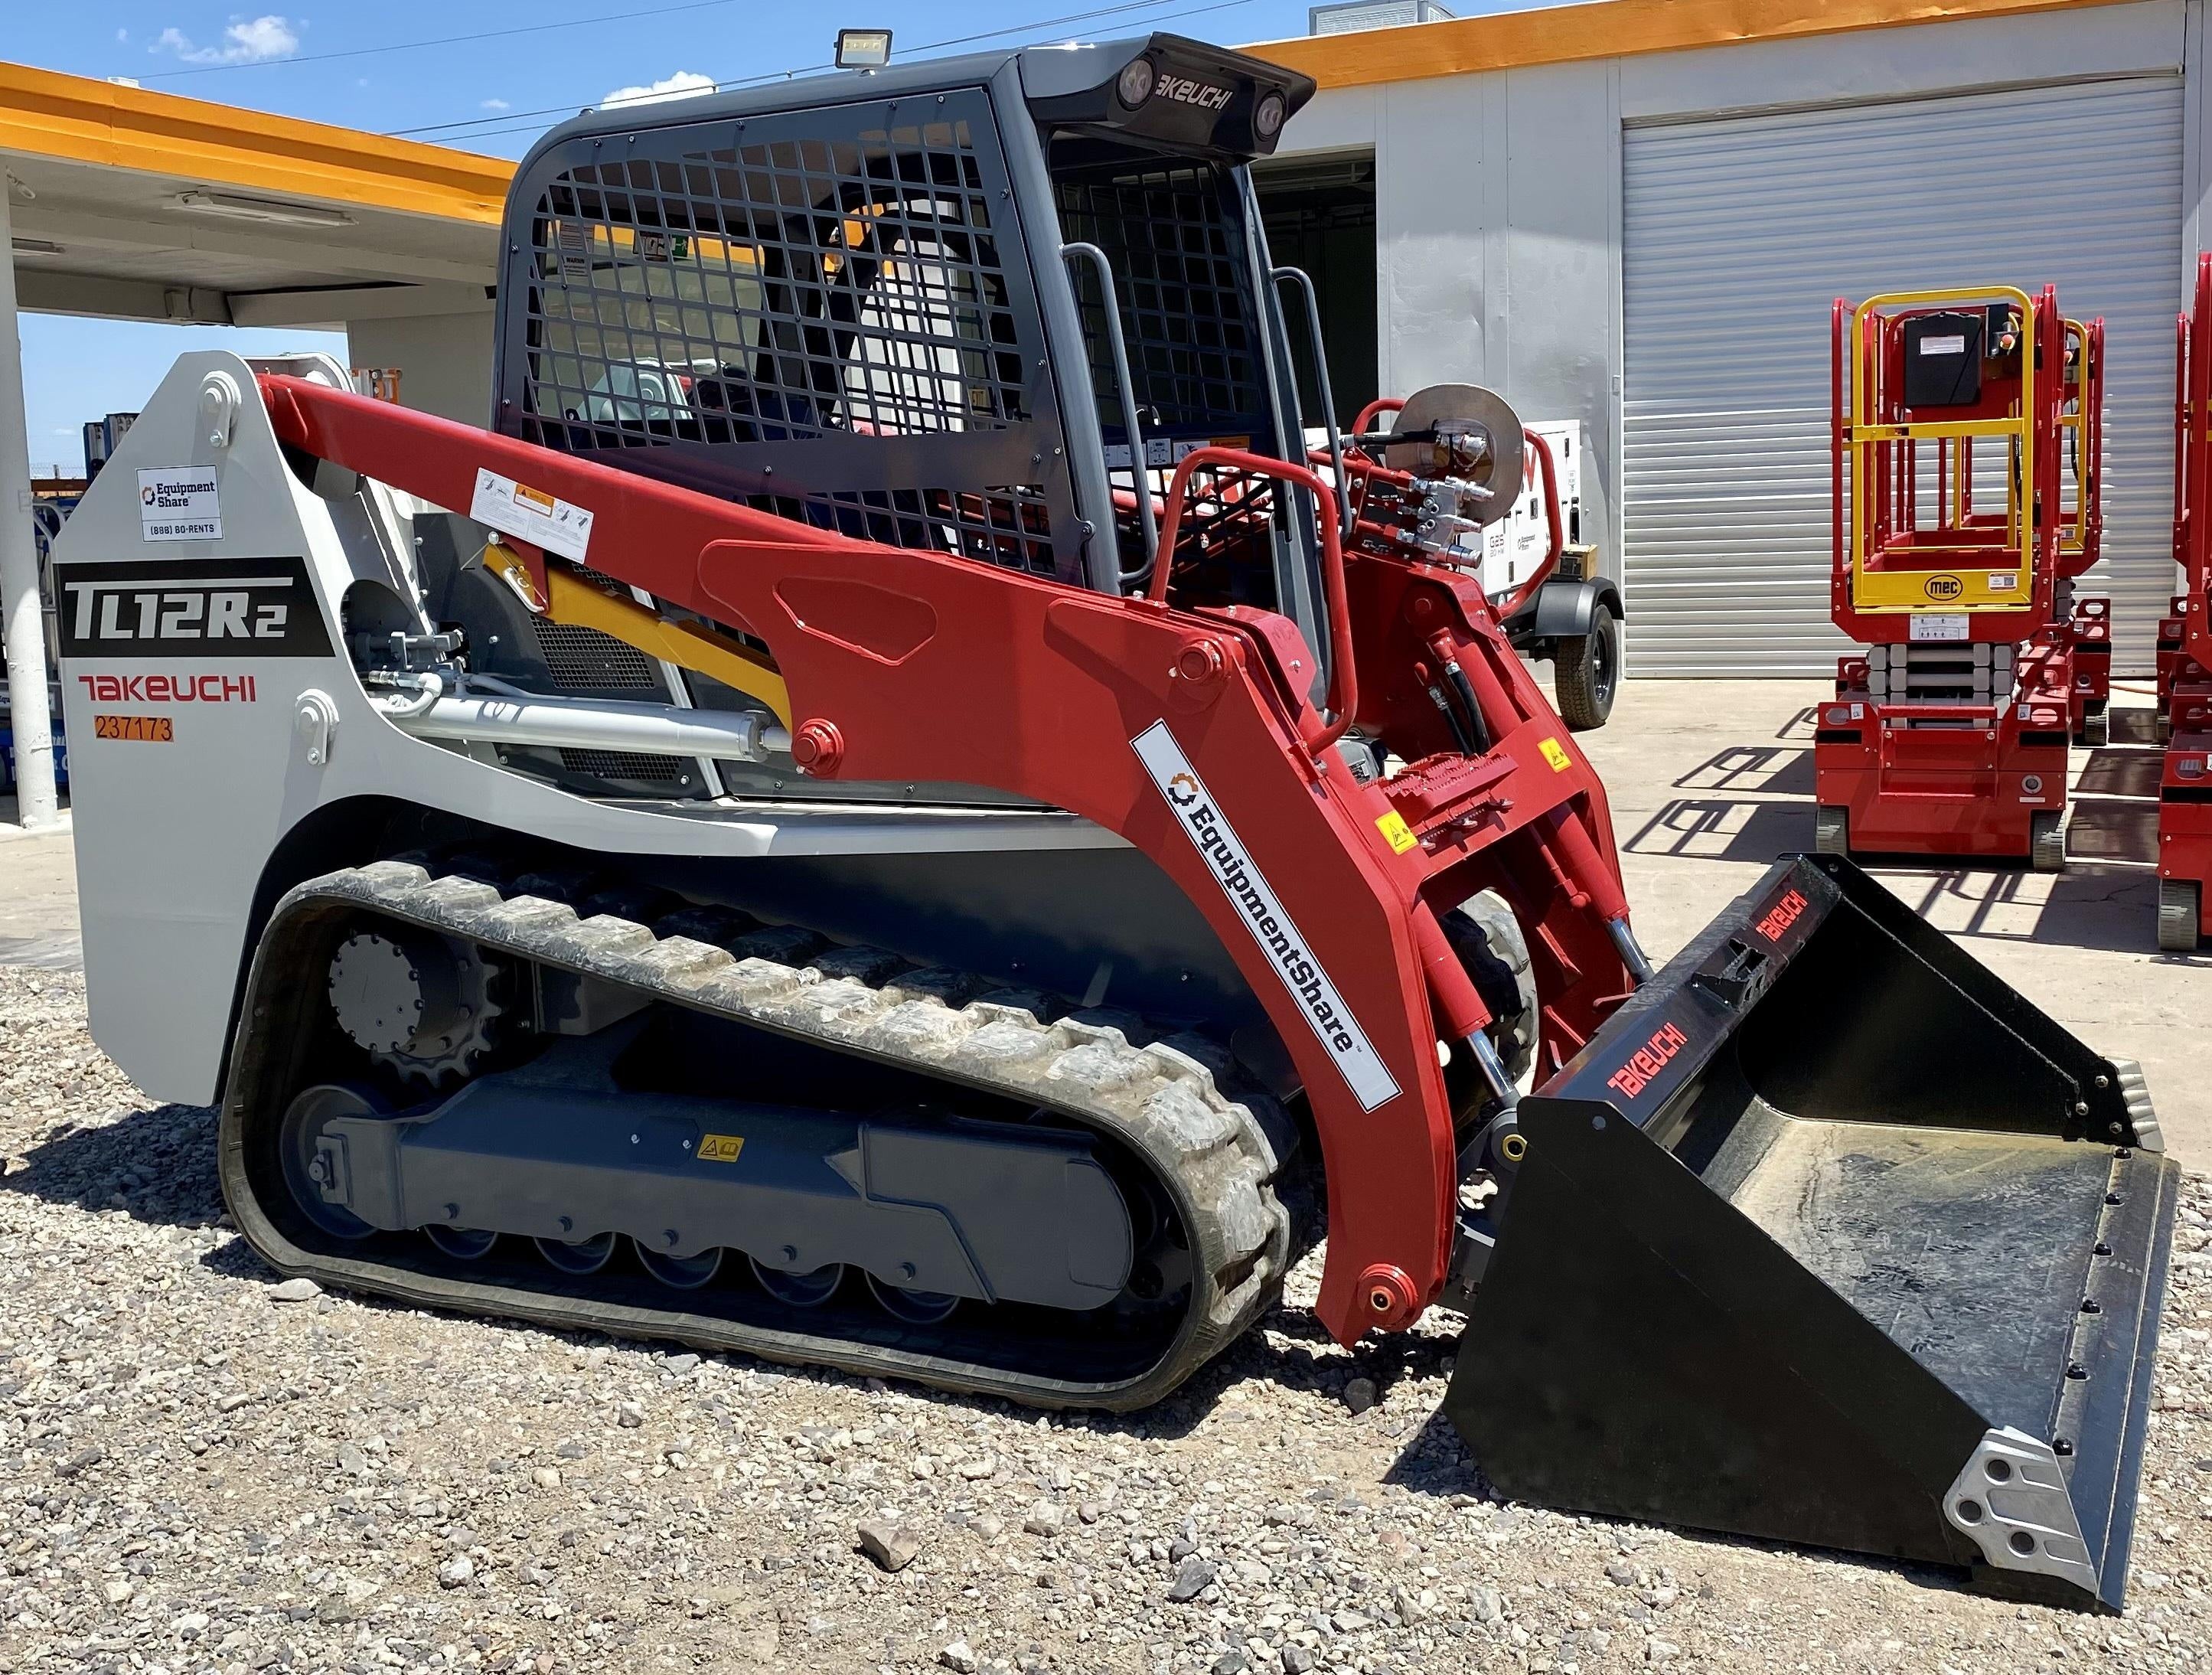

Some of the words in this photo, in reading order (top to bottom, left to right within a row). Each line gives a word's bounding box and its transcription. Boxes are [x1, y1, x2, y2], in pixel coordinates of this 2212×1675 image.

[1155, 74, 1233, 110] AKEUCHI
[156, 482, 215, 496] Equipment
[158, 497, 189, 508] Share
[150, 526, 172, 535] (888)
[65, 577, 293, 639] TL12R2
[96, 717, 173, 741] 237173
[1188, 804, 1353, 1053] EquipmentShare
